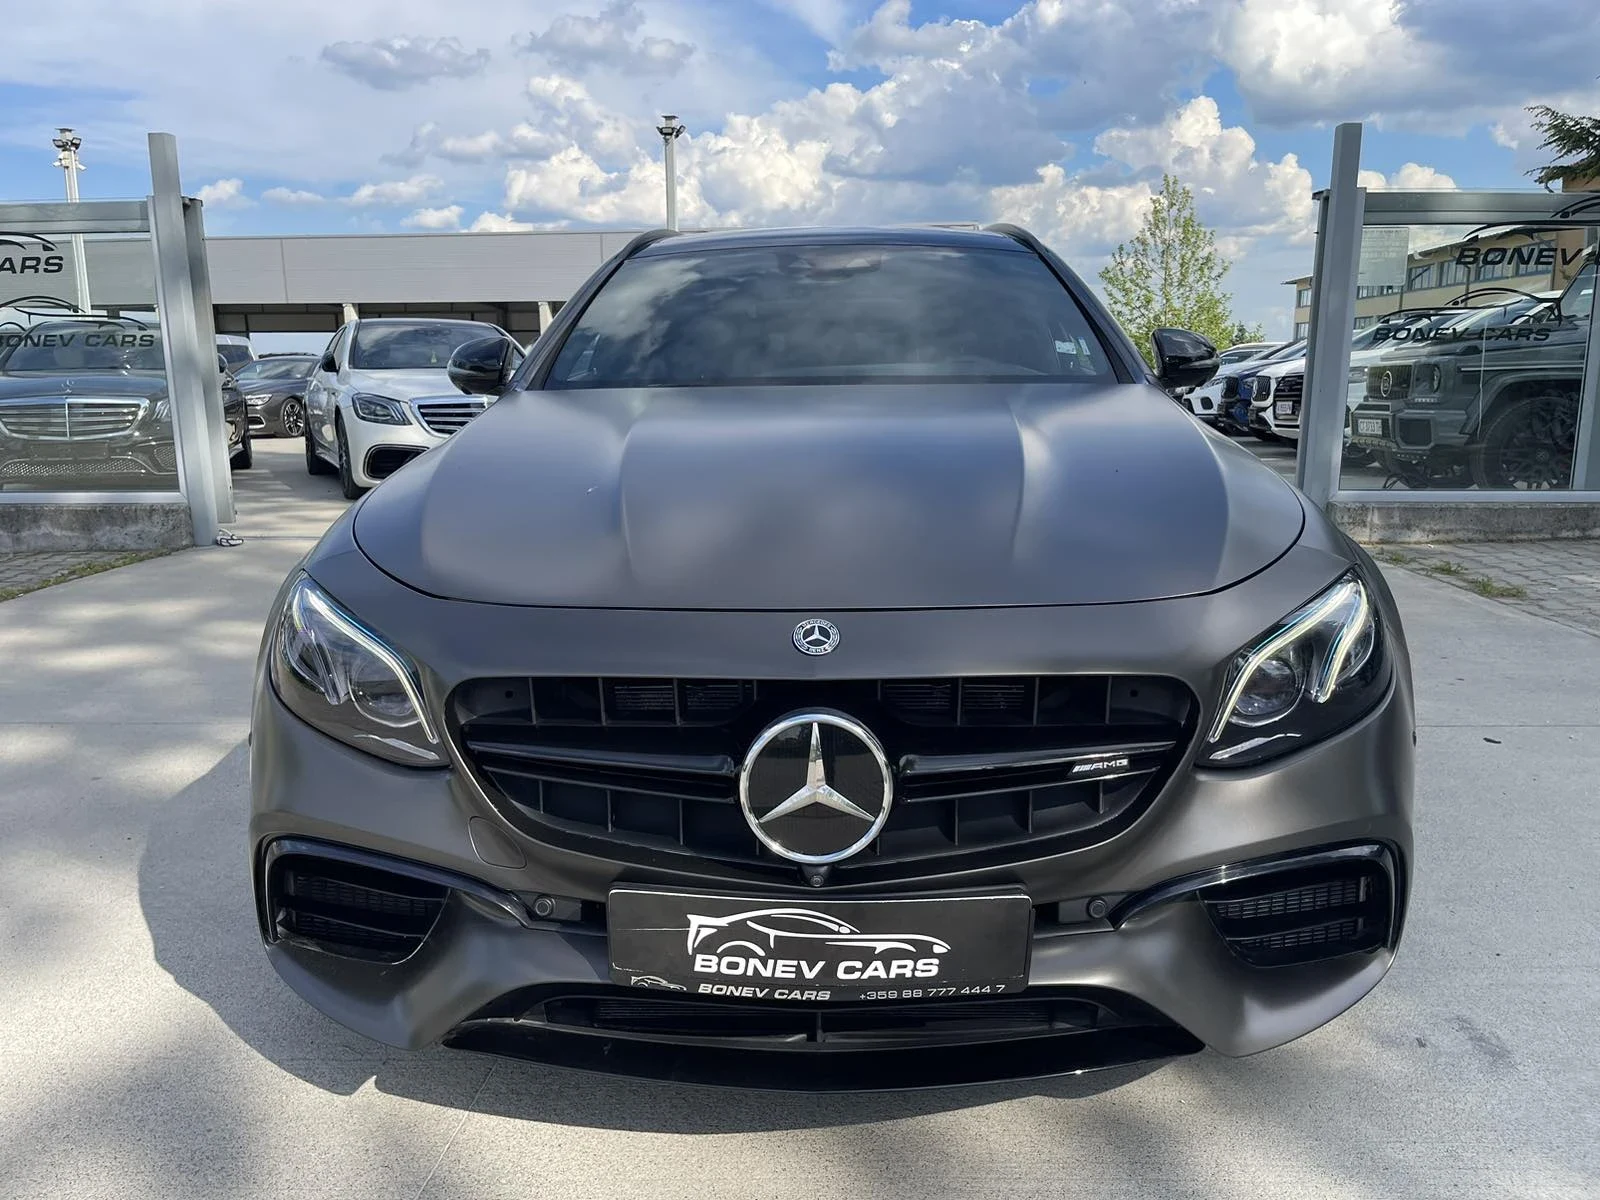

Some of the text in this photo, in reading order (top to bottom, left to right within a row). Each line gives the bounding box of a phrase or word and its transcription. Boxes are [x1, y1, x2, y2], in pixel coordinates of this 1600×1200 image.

[0, 255, 64, 274] ARS
[1455, 247, 1584, 266] BONEV
[85, 334, 154, 348] CARS
[1372, 327, 1552, 342] BONEV CARS
[1090, 758, 1129, 771] AMG
[693, 953, 940, 980] BONEV CARS
[698, 983, 831, 1001] BONEV CARS
[859, 984, 1006, 1000] +359 88 777 444 7
